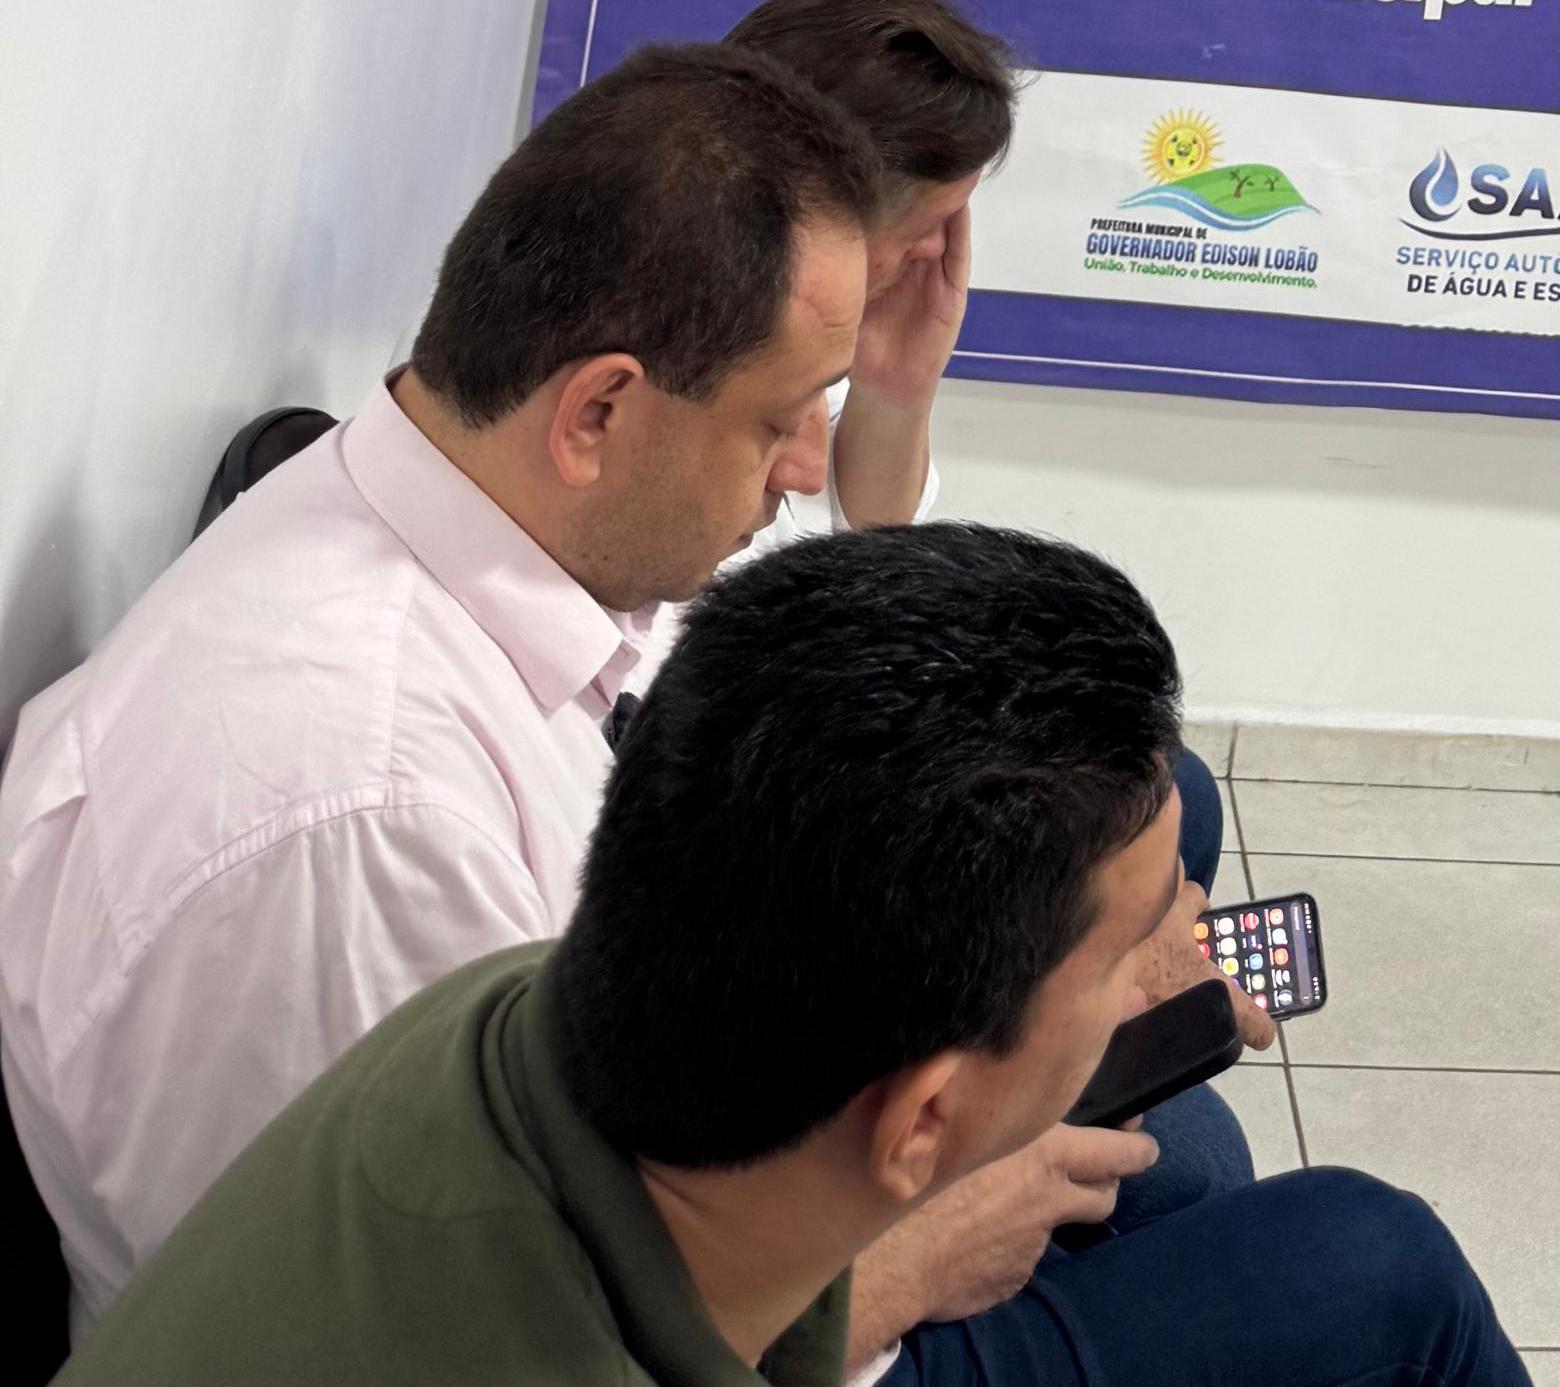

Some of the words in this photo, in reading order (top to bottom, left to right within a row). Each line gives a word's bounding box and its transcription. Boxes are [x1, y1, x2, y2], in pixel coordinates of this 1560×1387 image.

[1090, 218, 1143, 233] PREFEITURA
[1146, 222, 1193, 238] MUNICIPAL
[1196, 227, 1207, 240] DE
[1086, 233, 1196, 263] GOVERNADOR
[1201, 242, 1260, 267] EDISON
[1264, 246, 1318, 273] LOBÃO
[1396, 246, 1499, 275] SERVIÇO
[1084, 257, 1126, 274] União,
[1129, 260, 1188, 278] Trabalho
[1190, 268, 1200, 279] e
[1407, 273, 1437, 293] DE
[1442, 272, 1507, 298] ÁGUA
[1514, 280, 1527, 299] E
